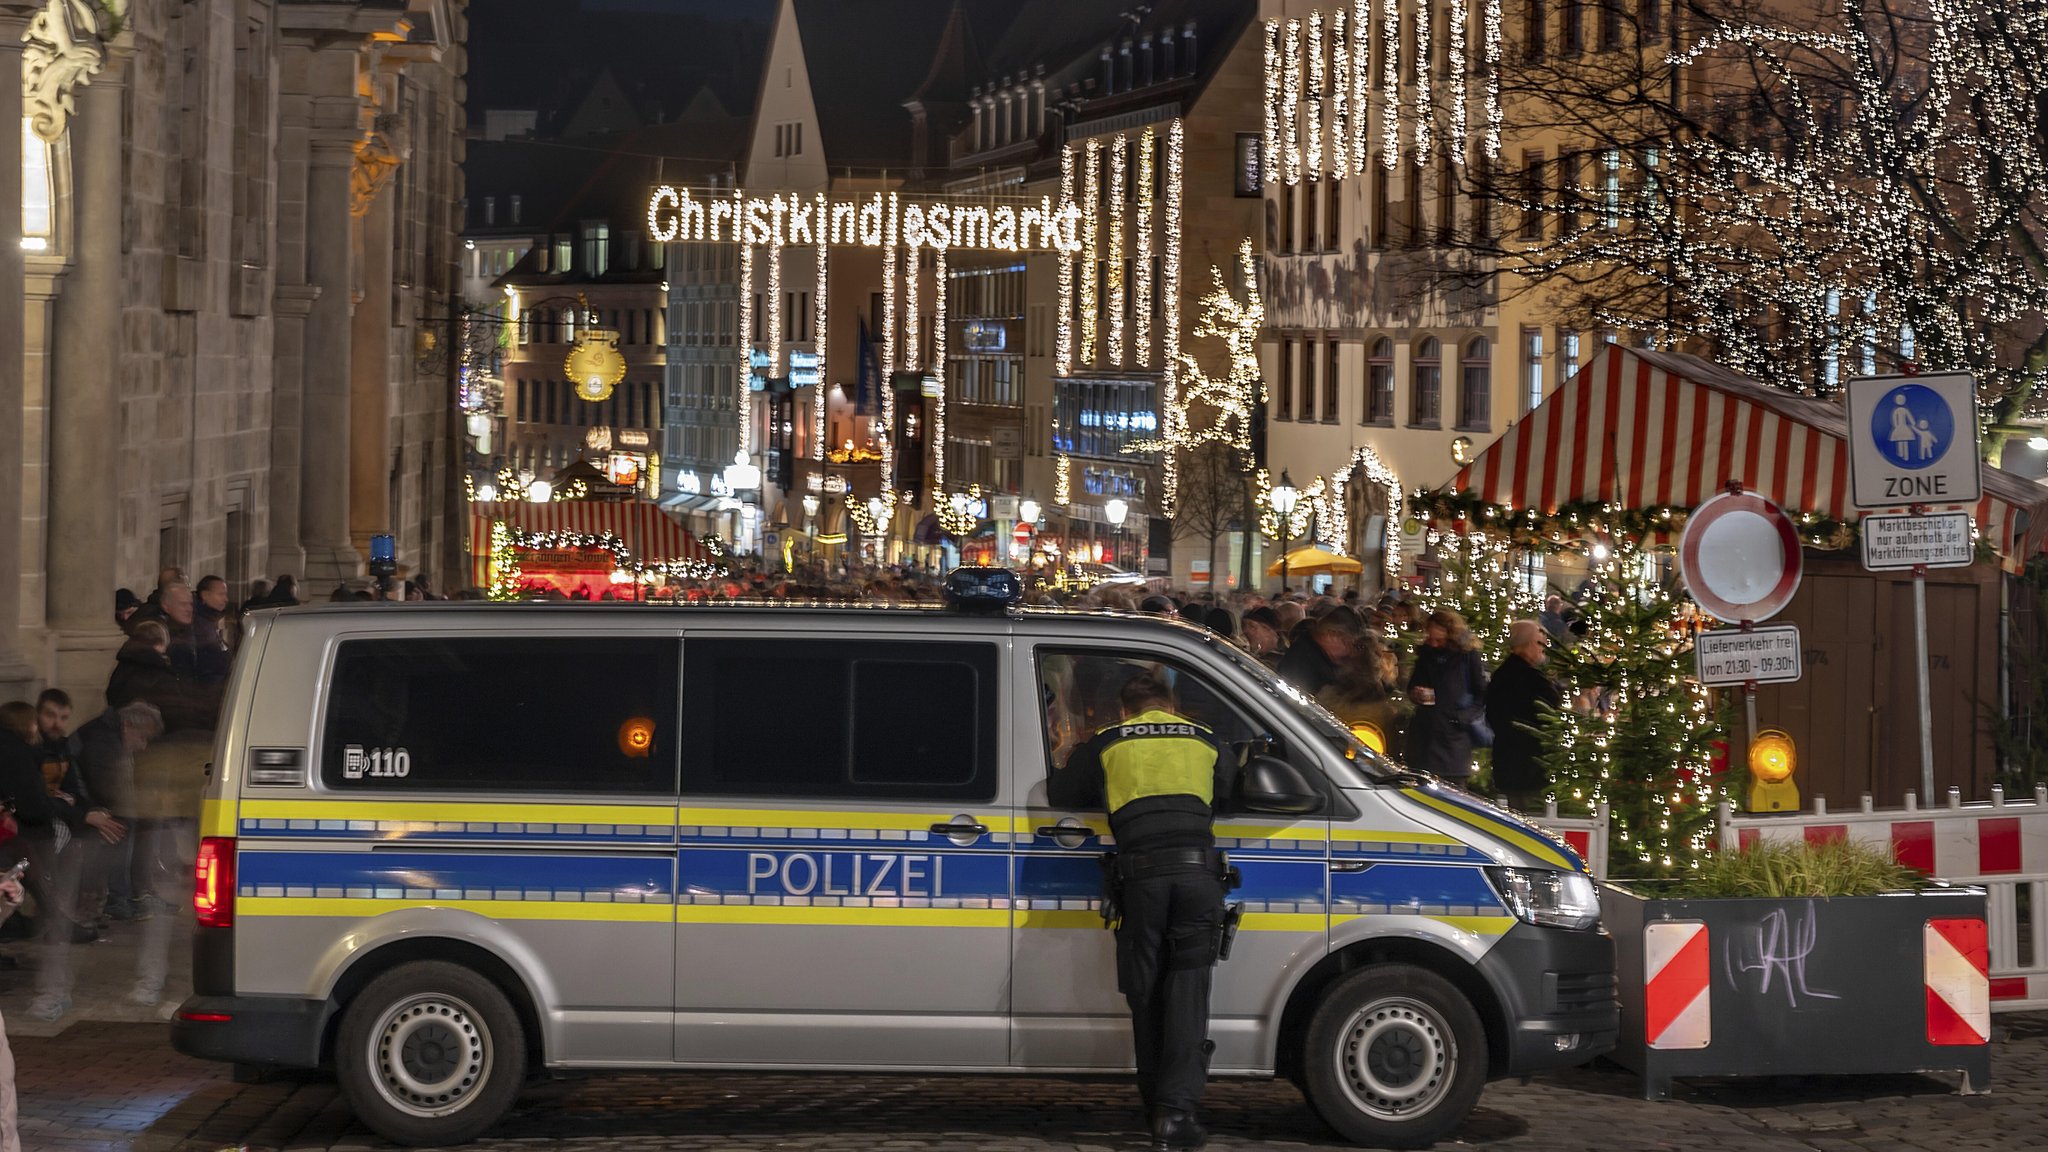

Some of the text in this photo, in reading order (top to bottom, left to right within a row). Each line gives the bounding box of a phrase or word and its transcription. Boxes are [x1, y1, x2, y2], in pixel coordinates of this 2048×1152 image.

[648, 185, 1082, 251] Christkindlesmarkt
[1885, 475, 1948, 498] ZONE
[1879, 517, 1957, 533] Marktbeschicker
[1877, 530, 1960, 546] nur außerhalb der
[1871, 544, 1951, 561] Marktöffnungszeit
[1703, 634, 1794, 654] Lieferverkehr frei
[1705, 664, 1722, 676] von
[1725, 660, 1751, 675] 21:30
[1761, 657, 1795, 672] 09:30h
[1121, 724, 1196, 738] POLIZEI
[369, 747, 411, 778] 110
[748, 852, 943, 898] POLIZEI
